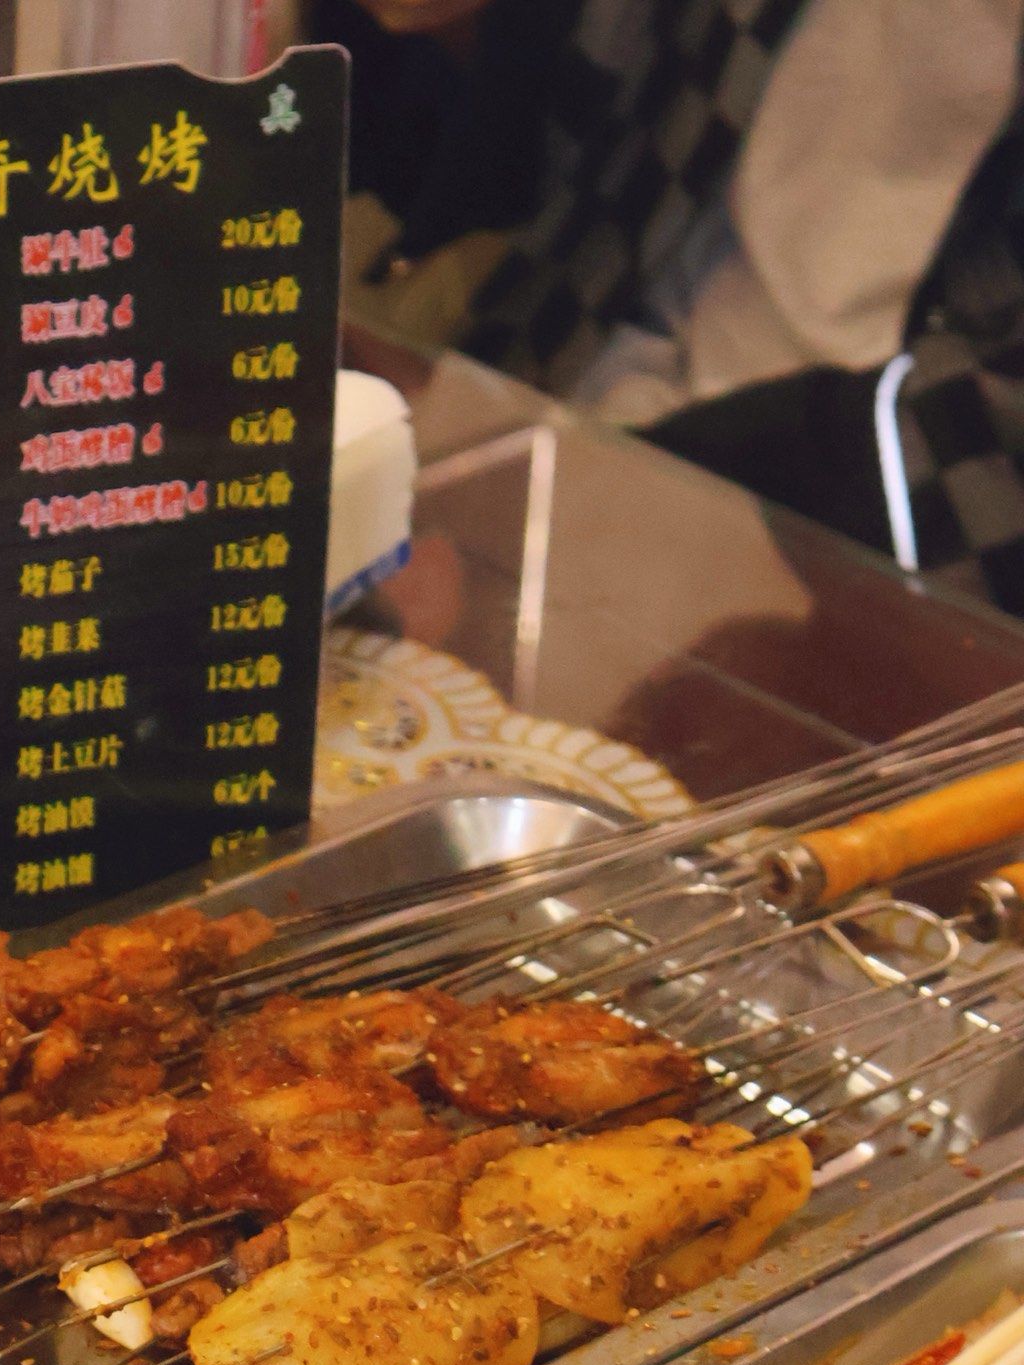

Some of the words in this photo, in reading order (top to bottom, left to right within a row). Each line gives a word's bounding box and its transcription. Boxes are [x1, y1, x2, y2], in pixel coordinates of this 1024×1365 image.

[221, 208, 303, 249] 20元/份
[223, 275, 301, 315] 10元/份
[231, 341, 300, 381] 6元/份
[229, 406, 296, 446] 6元/份
[216, 470, 294, 509] 10元/份
